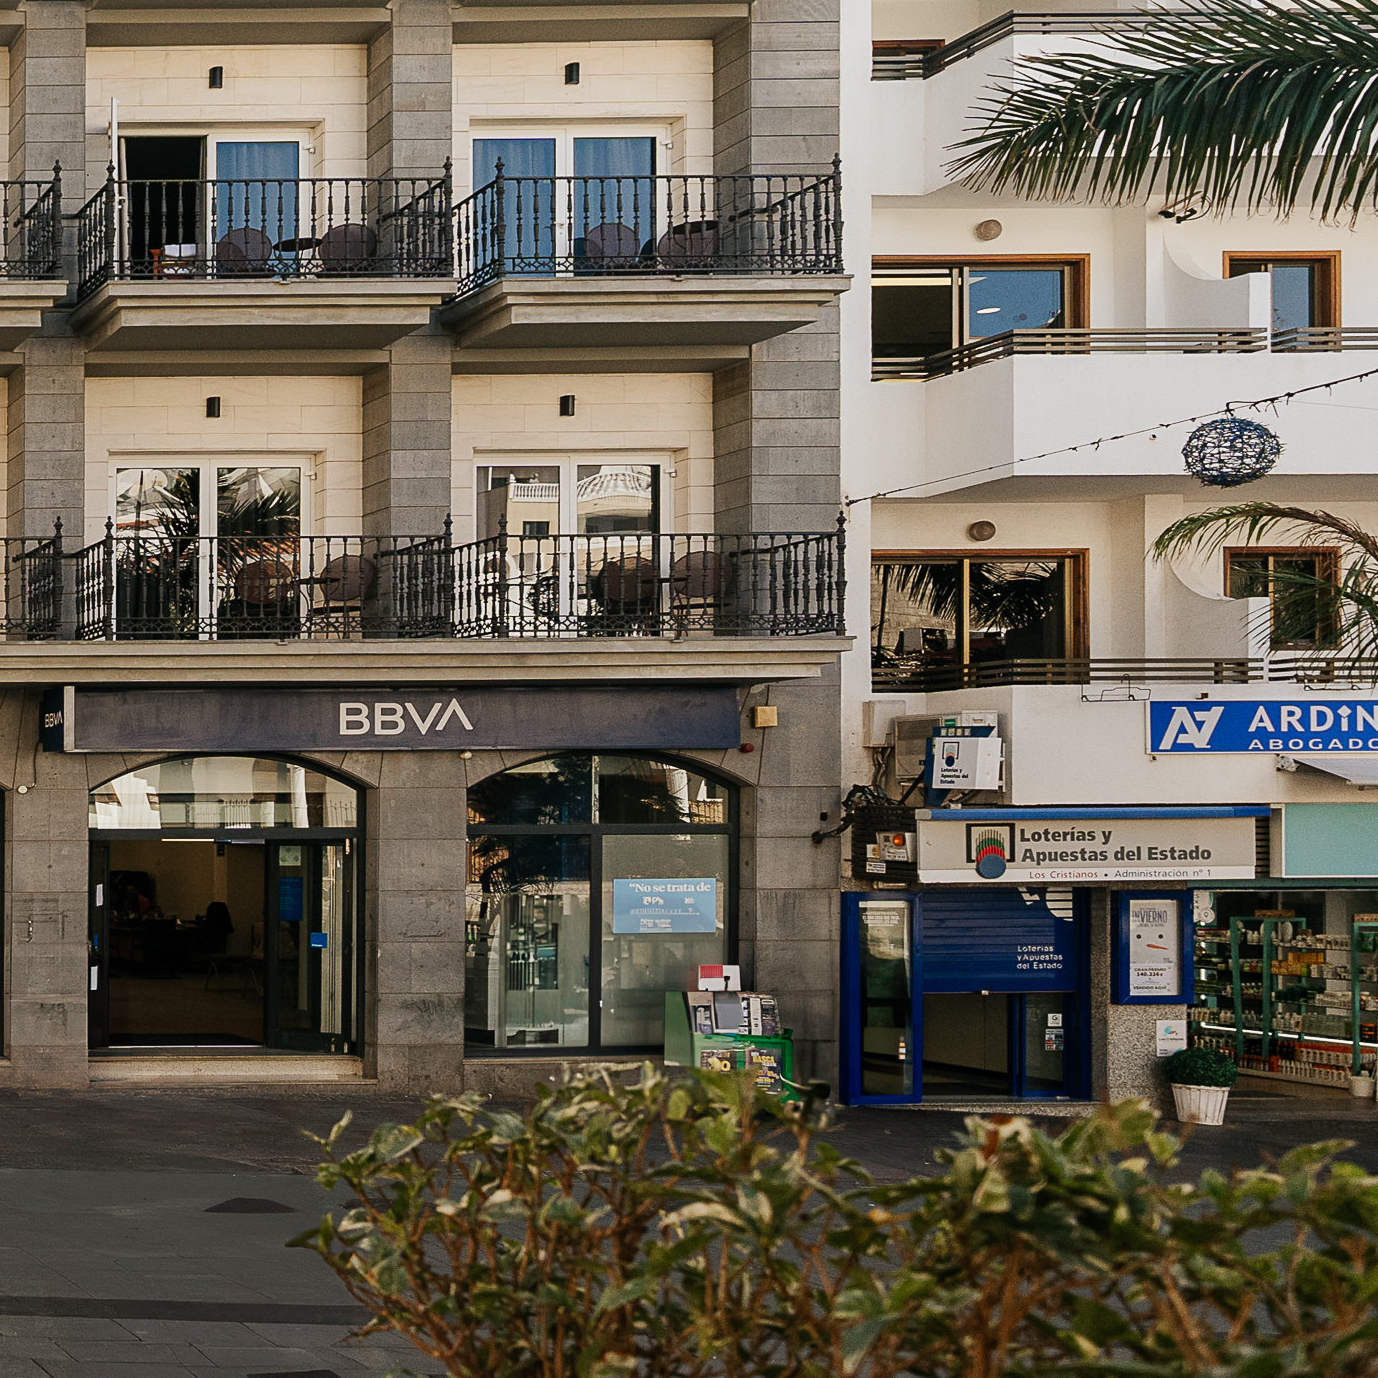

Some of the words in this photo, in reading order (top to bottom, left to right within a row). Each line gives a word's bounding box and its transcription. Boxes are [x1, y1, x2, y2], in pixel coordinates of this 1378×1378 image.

[44, 710, 63, 728] BBVA
[339, 698, 473, 736] BBVA
[1020, 827, 1096, 842] Loterías
[1101, 830, 1112, 845] y
[1021, 848, 1108, 866] Apuestas
[1113, 846, 1142, 861] del
[1147, 845, 1212, 861] Estado
[1029, 871, 1046, 879] Los
[1050, 870, 1098, 879] Cristianos
[1114, 869, 1188, 878] Administración
[652, 884, 666, 892] se
[666, 883, 695, 893] trata
[696, 882, 711, 892] de
[1033, 961, 1063, 969] Estado
